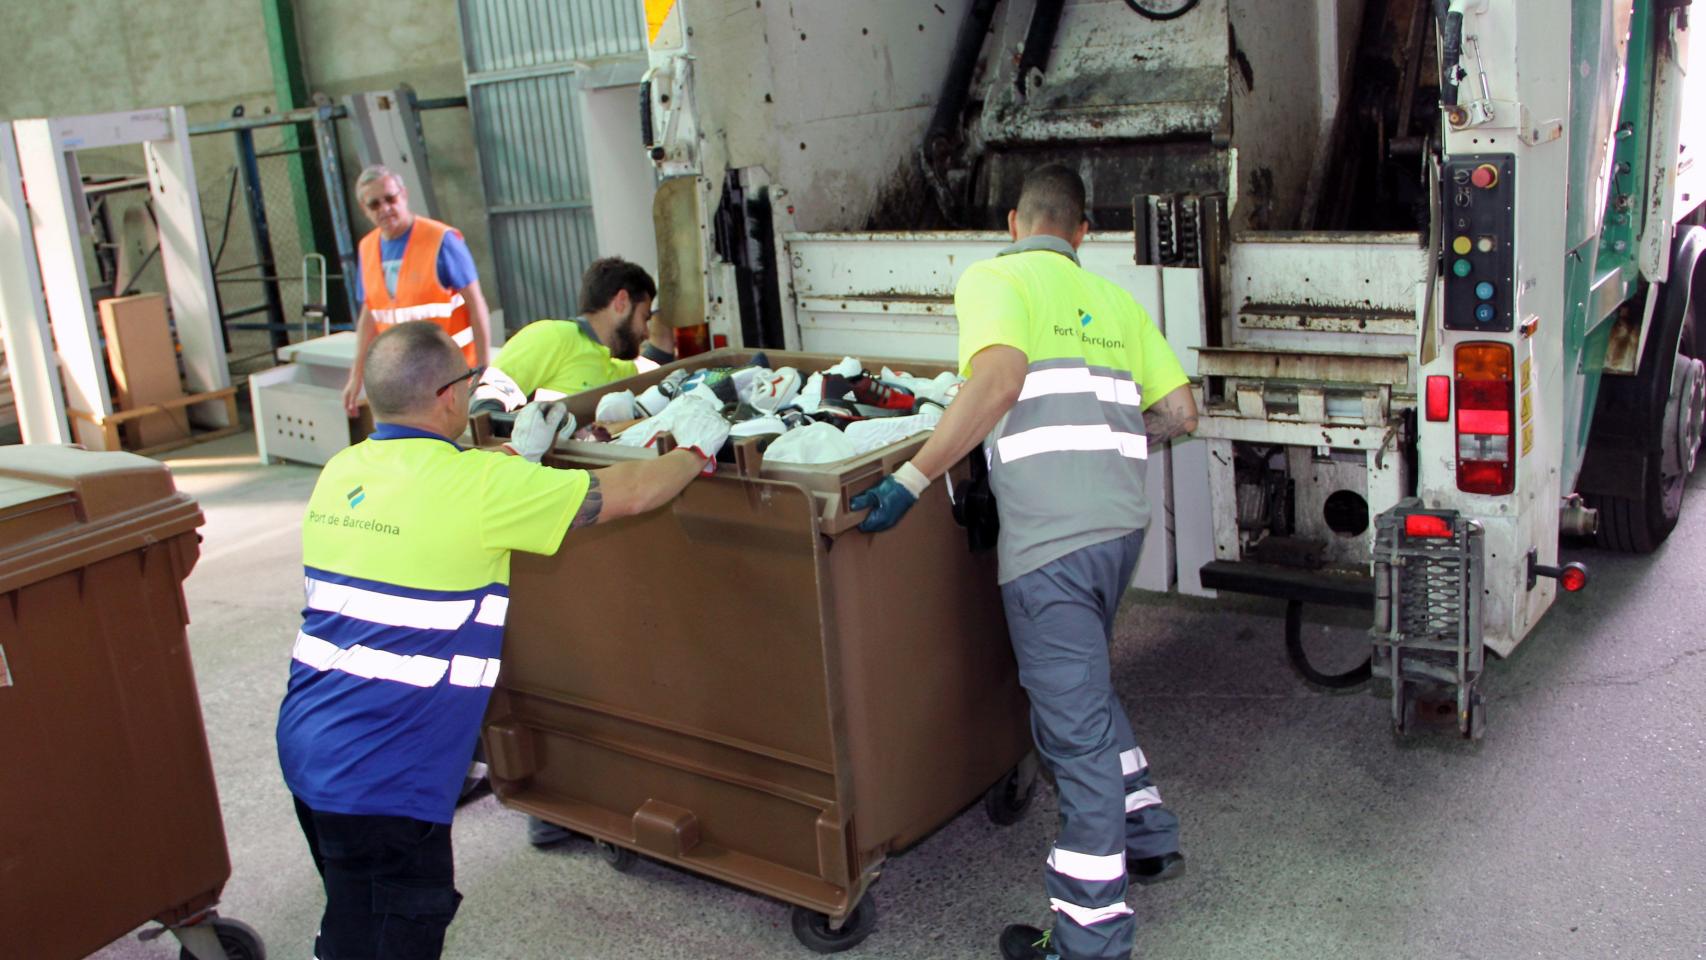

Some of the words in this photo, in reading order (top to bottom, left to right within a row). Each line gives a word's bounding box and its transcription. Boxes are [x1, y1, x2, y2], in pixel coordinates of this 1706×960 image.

[1054, 325, 1074, 336] Port
[310, 510, 326, 524] Port
[327, 512, 340, 526] de
[343, 515, 401, 536] Barcelona
